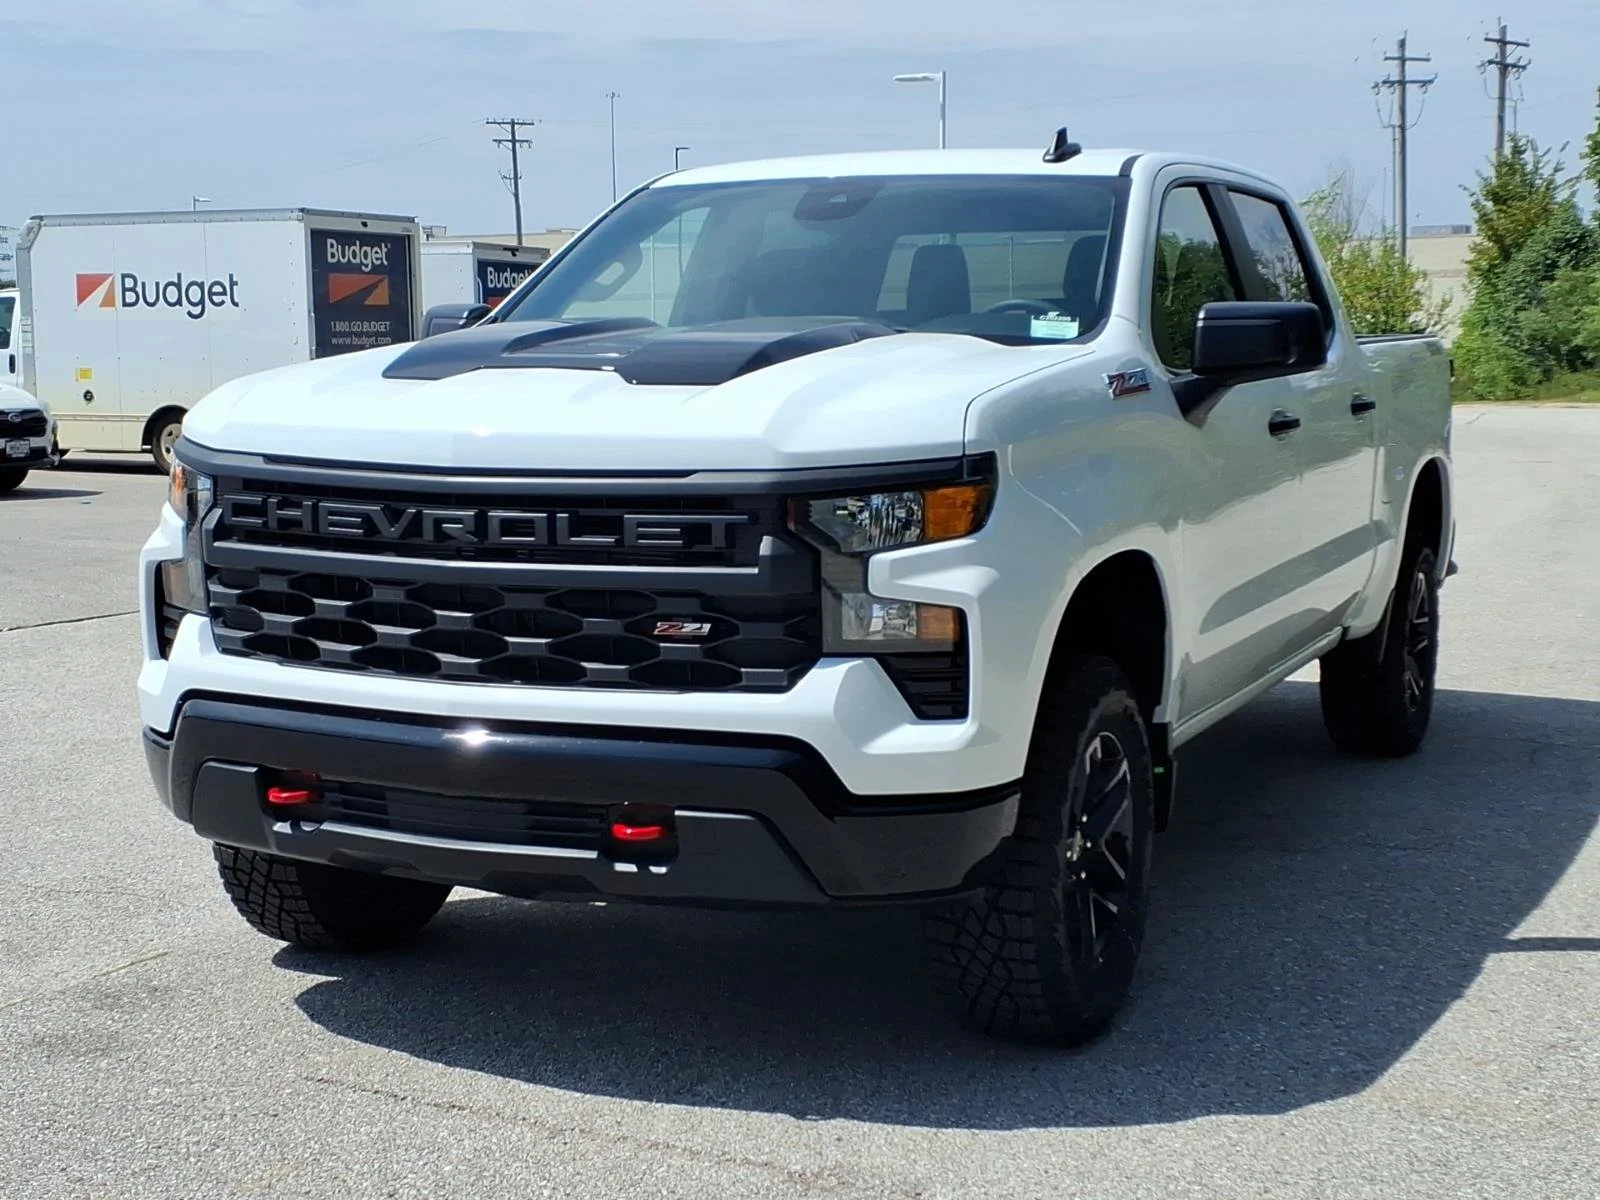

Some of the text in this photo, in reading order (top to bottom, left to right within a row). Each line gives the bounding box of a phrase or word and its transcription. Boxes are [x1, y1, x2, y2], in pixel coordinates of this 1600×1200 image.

[326, 238, 388, 273] Budget
[120, 272, 240, 319] Budget
[331, 335, 392, 347] www.budget.com
[222, 493, 749, 548] CHEVROLET
[653, 621, 712, 635] Z71
